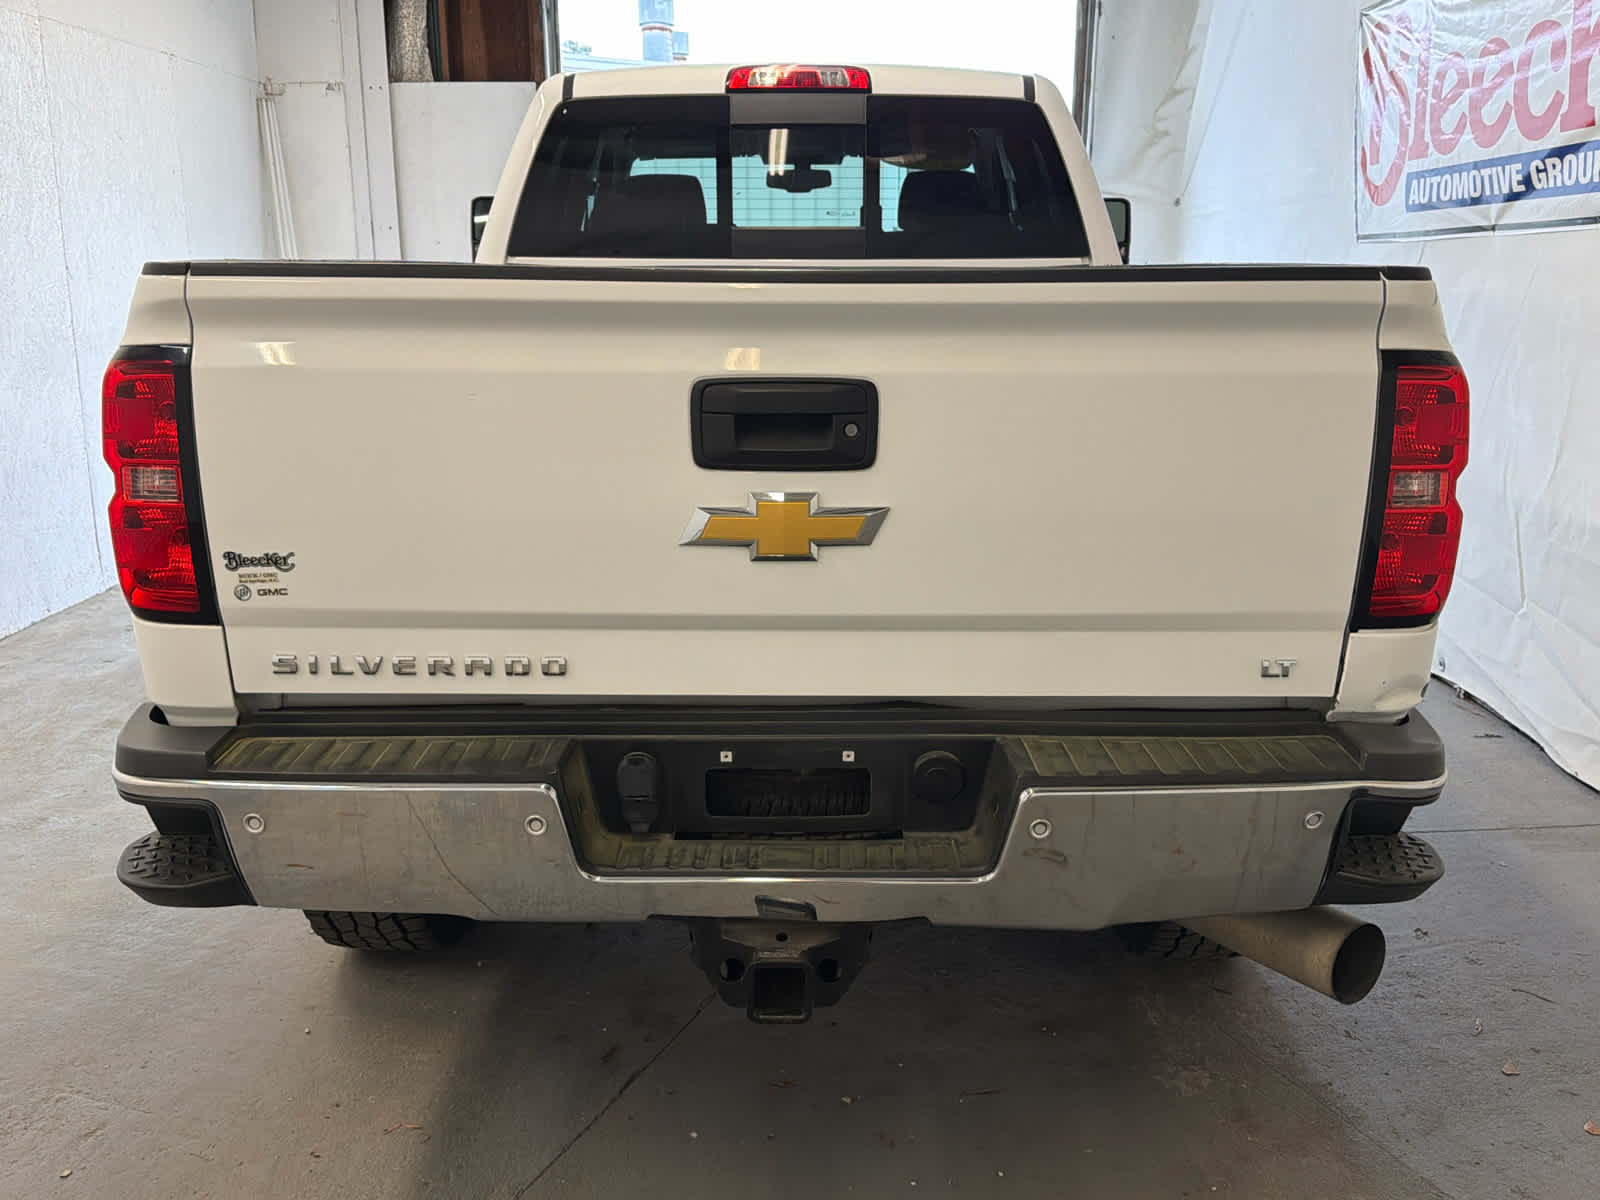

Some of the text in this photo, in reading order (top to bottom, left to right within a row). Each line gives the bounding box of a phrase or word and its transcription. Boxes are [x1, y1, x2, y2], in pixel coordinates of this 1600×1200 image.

[1408, 163, 1526, 205] AUTOMOTIVE
[222, 551, 296, 572] Bleecker
[257, 588, 288, 596] GMC
[272, 654, 568, 677] SILVERADO
[1261, 658, 1297, 678] LT
